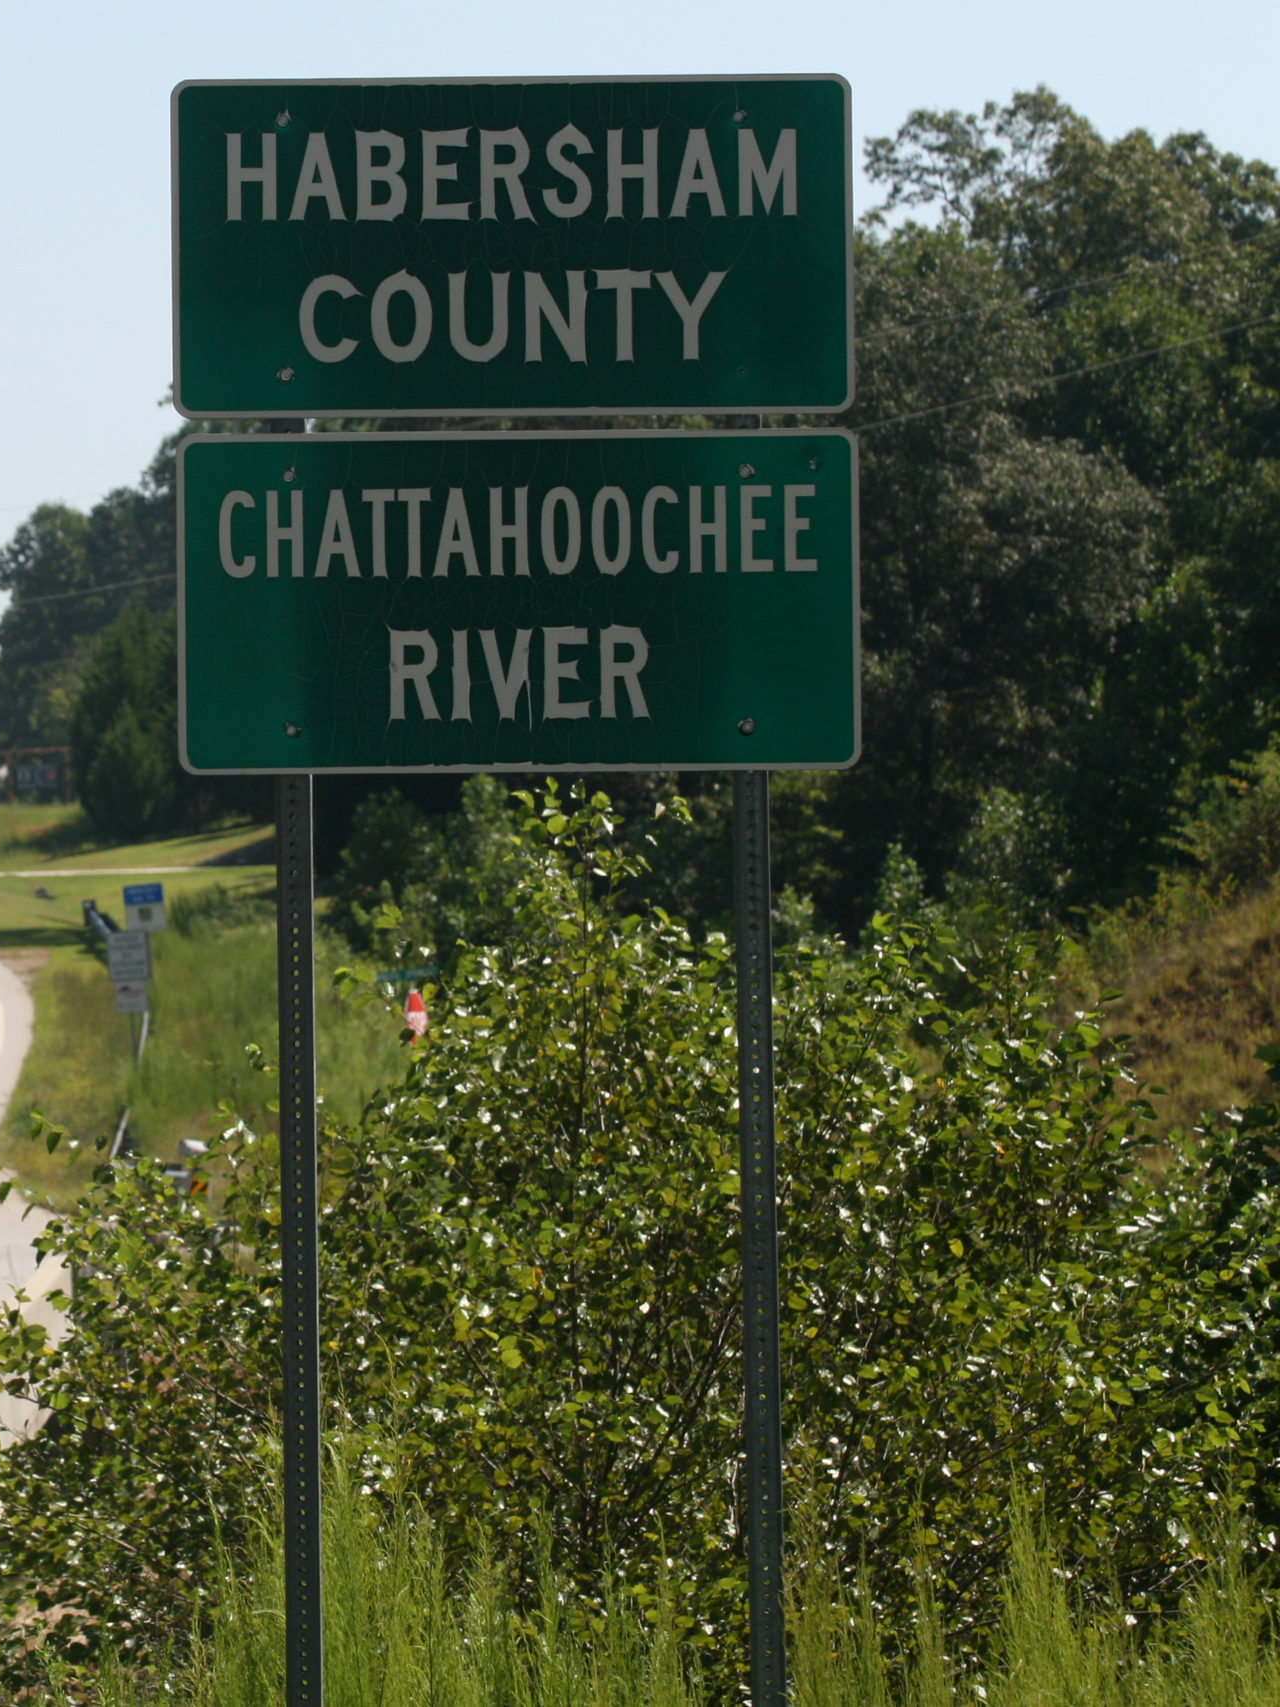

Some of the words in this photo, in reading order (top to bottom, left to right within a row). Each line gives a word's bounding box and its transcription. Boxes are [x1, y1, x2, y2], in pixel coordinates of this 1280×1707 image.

[226, 123, 798, 223] HABERSHAM
[299, 269, 728, 363] COUNTY
[218, 485, 818, 578] CHATTAHOOCHEE
[387, 624, 651, 728] RIVER
